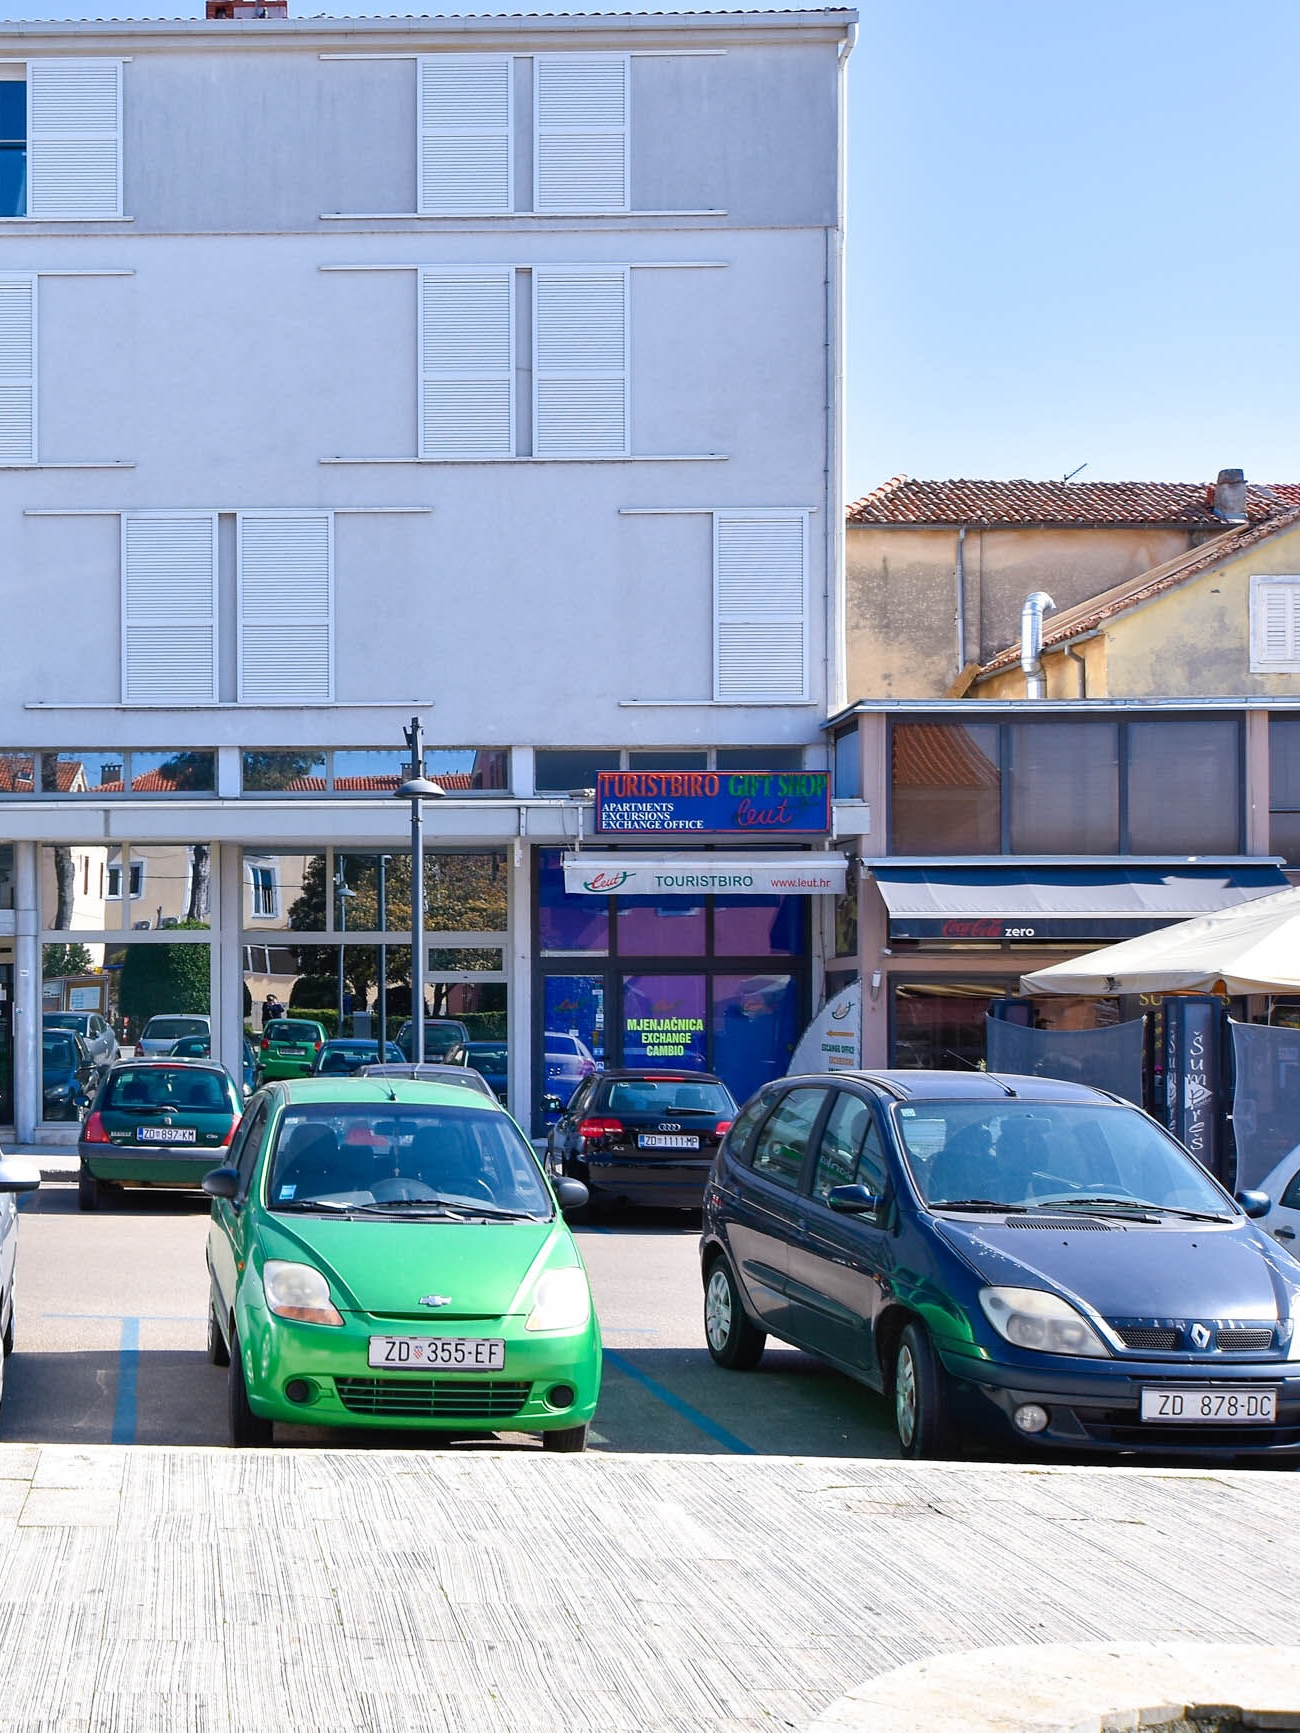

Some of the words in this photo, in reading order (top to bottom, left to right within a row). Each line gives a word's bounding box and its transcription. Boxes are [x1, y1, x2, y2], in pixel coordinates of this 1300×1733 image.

[601, 775, 720, 798] TURISTBIRO
[728, 775, 773, 797] GIFT
[778, 775, 827, 797] SHOP
[602, 802, 674, 812] APARTMENTS
[602, 811, 670, 821] EXCURSIONS
[602, 820, 661, 830] EXCHANGE
[663, 820, 704, 829] OFFICE
[655, 875, 754, 888] TOURISTBIRO
[771, 878, 831, 888] www.leut.hr
[1004, 928, 1035, 937] zero
[626, 1016, 704, 1031] MJENJAČNICA
[641, 1033, 692, 1044] EXCHANGE
[646, 1045, 685, 1056] CAMBIO
[143, 1129, 155, 1139] ZD
[161, 1129, 195, 1140] 897-KM
[645, 1136, 657, 1146] ZD
[384, 1341, 411, 1362] ZD
[426, 1341, 499, 1364] 355-EF
[1158, 1394, 1184, 1416] ZD
[1200, 1395, 1272, 1416] 878-DC
